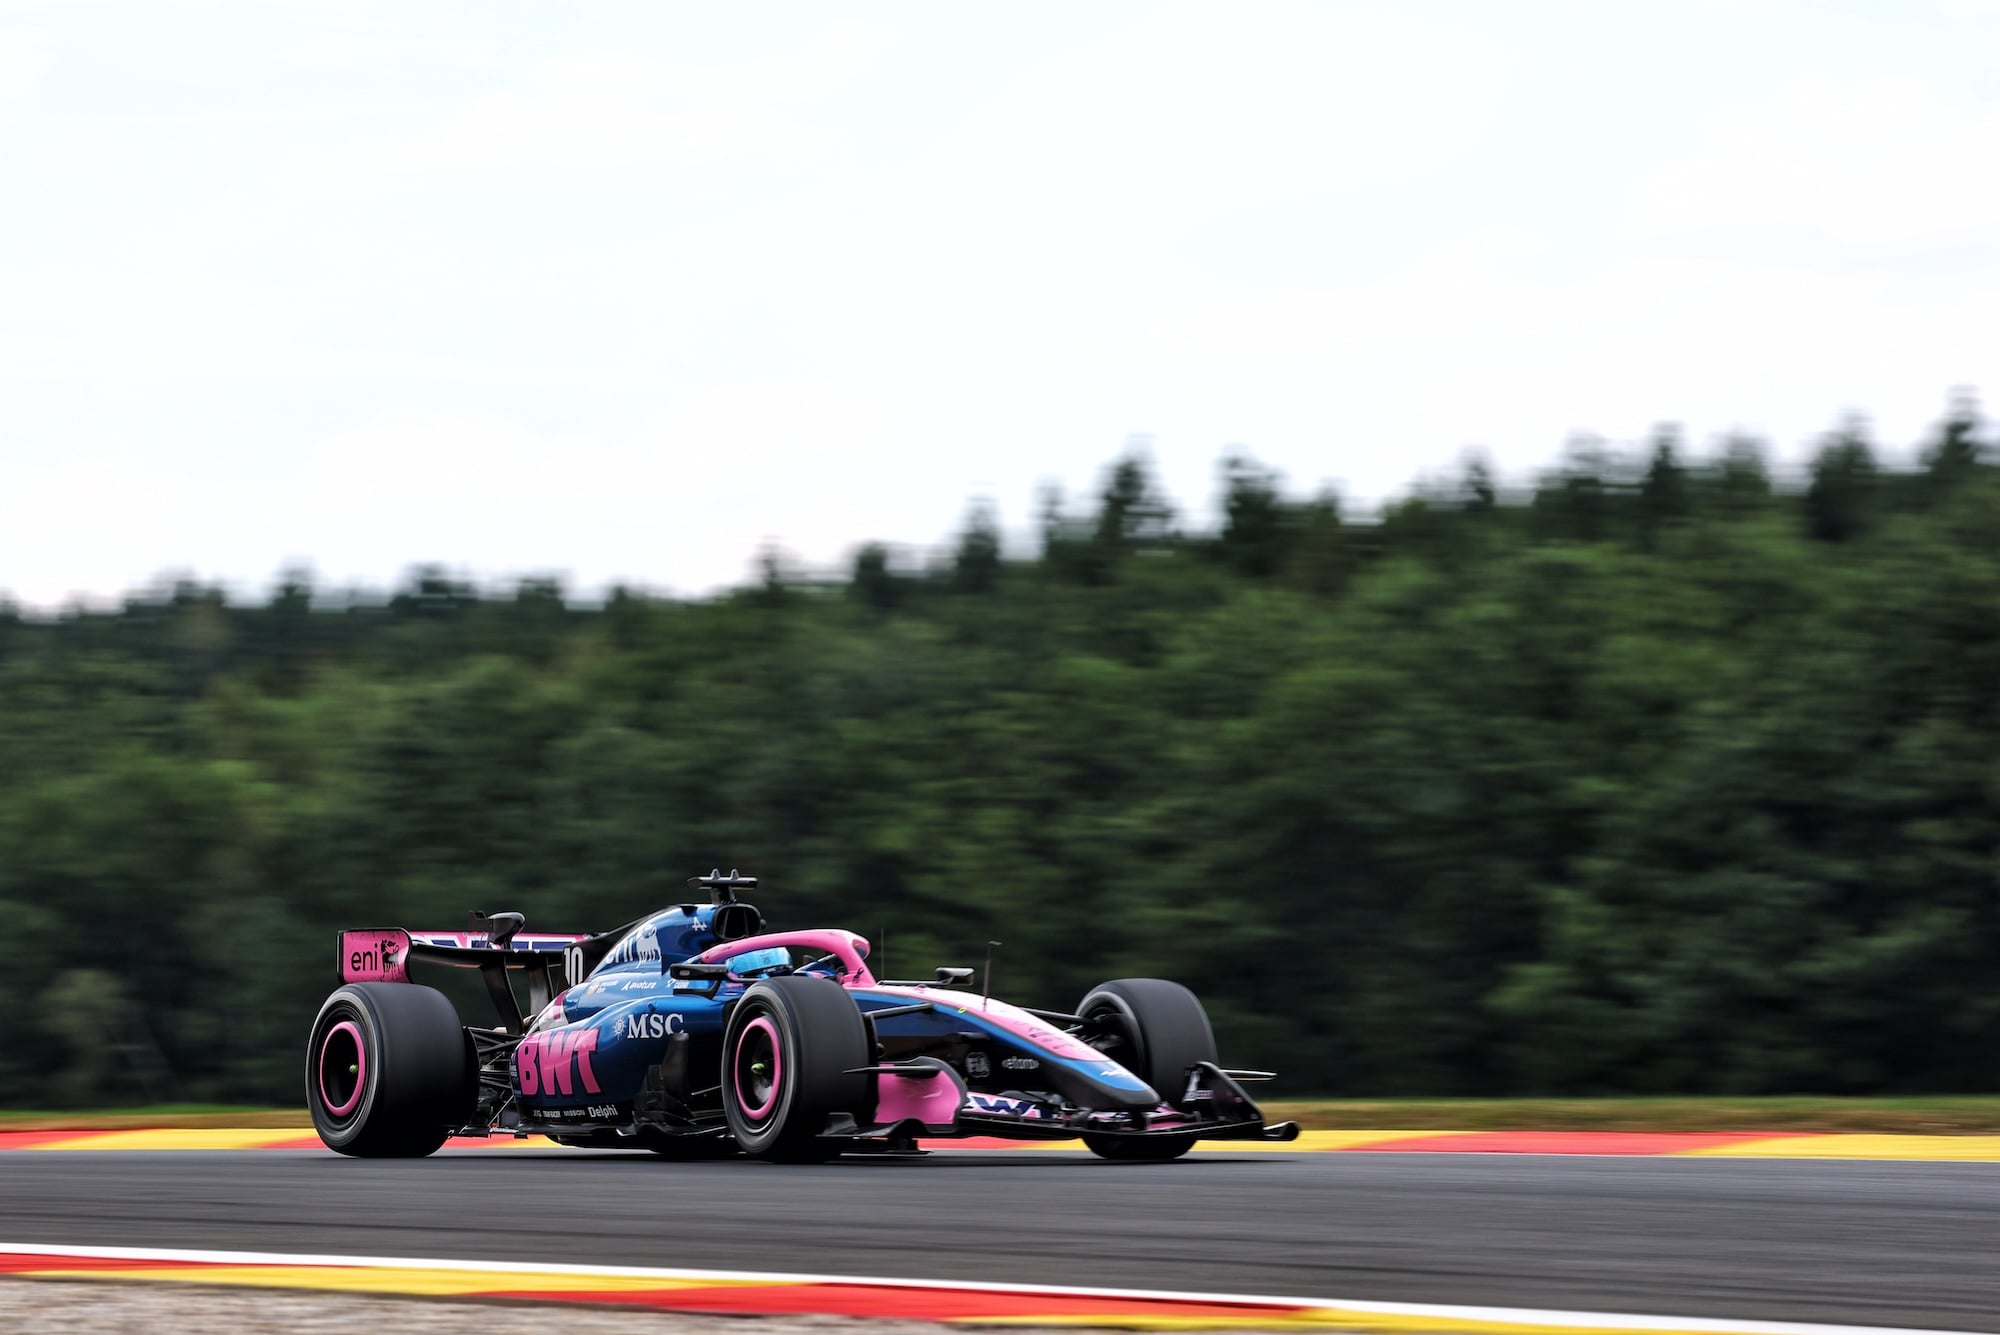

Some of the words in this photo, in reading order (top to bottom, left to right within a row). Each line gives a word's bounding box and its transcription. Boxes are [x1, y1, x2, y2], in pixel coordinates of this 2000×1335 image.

[351, 943, 378, 971] eni
[563, 946, 585, 987] 10
[626, 1013, 685, 1039] MSC
[517, 1028, 603, 1096] BWT
[588, 1104, 618, 1119] Delphi
